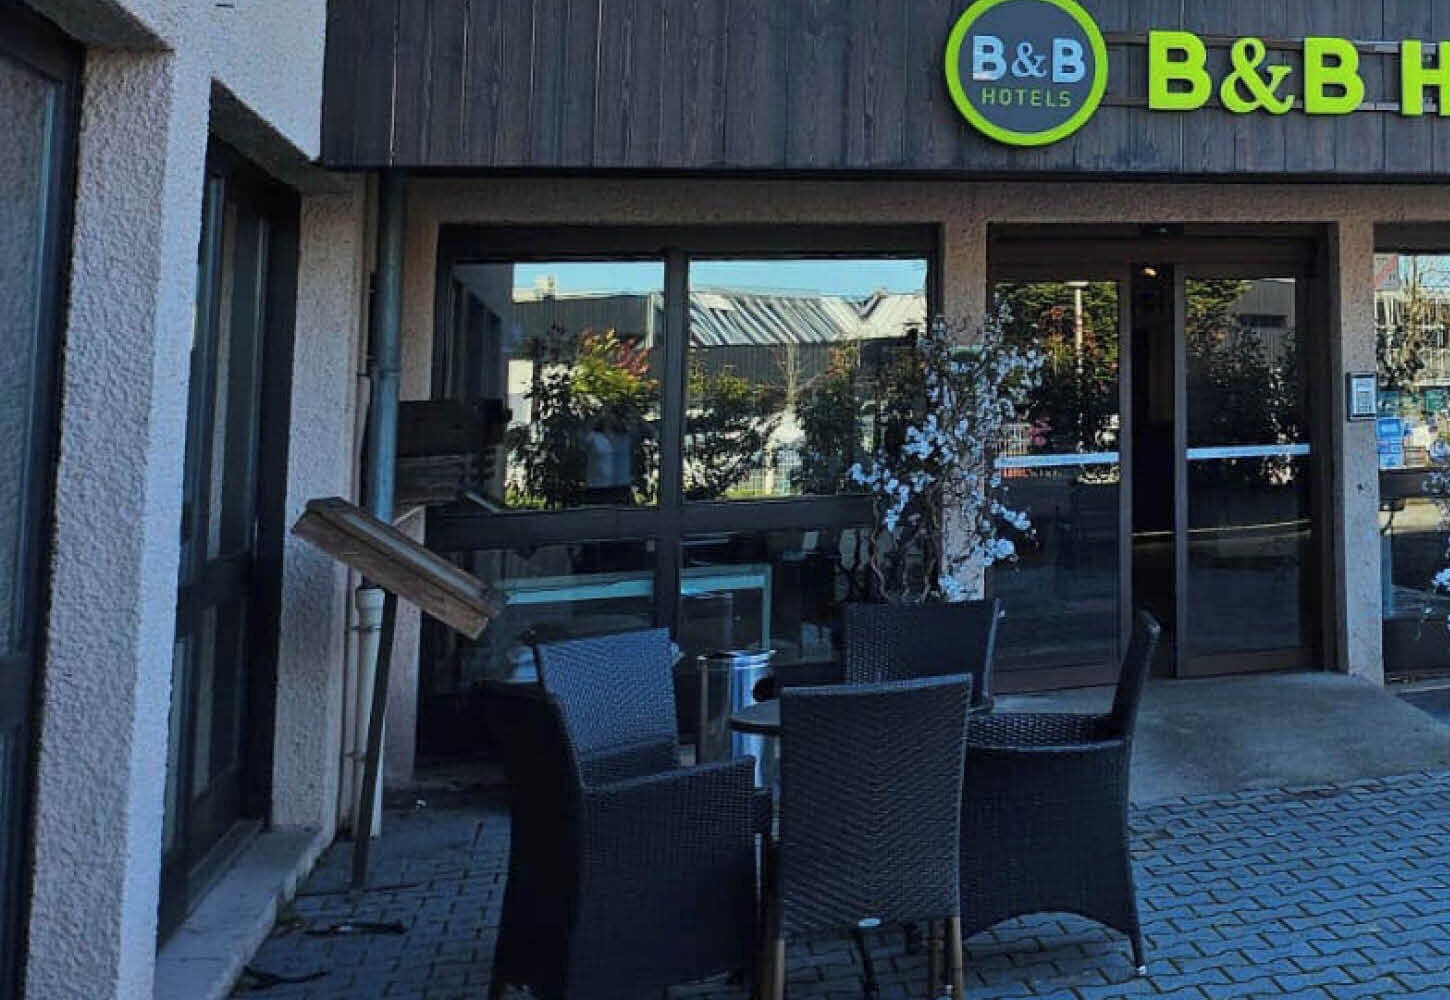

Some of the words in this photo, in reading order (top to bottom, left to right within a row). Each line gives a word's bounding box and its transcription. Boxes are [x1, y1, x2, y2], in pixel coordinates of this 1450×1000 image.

[973, 35, 1085, 83] B&B
[1149, 30, 1365, 114] B&B
[981, 87, 1072, 107] HOTELS
